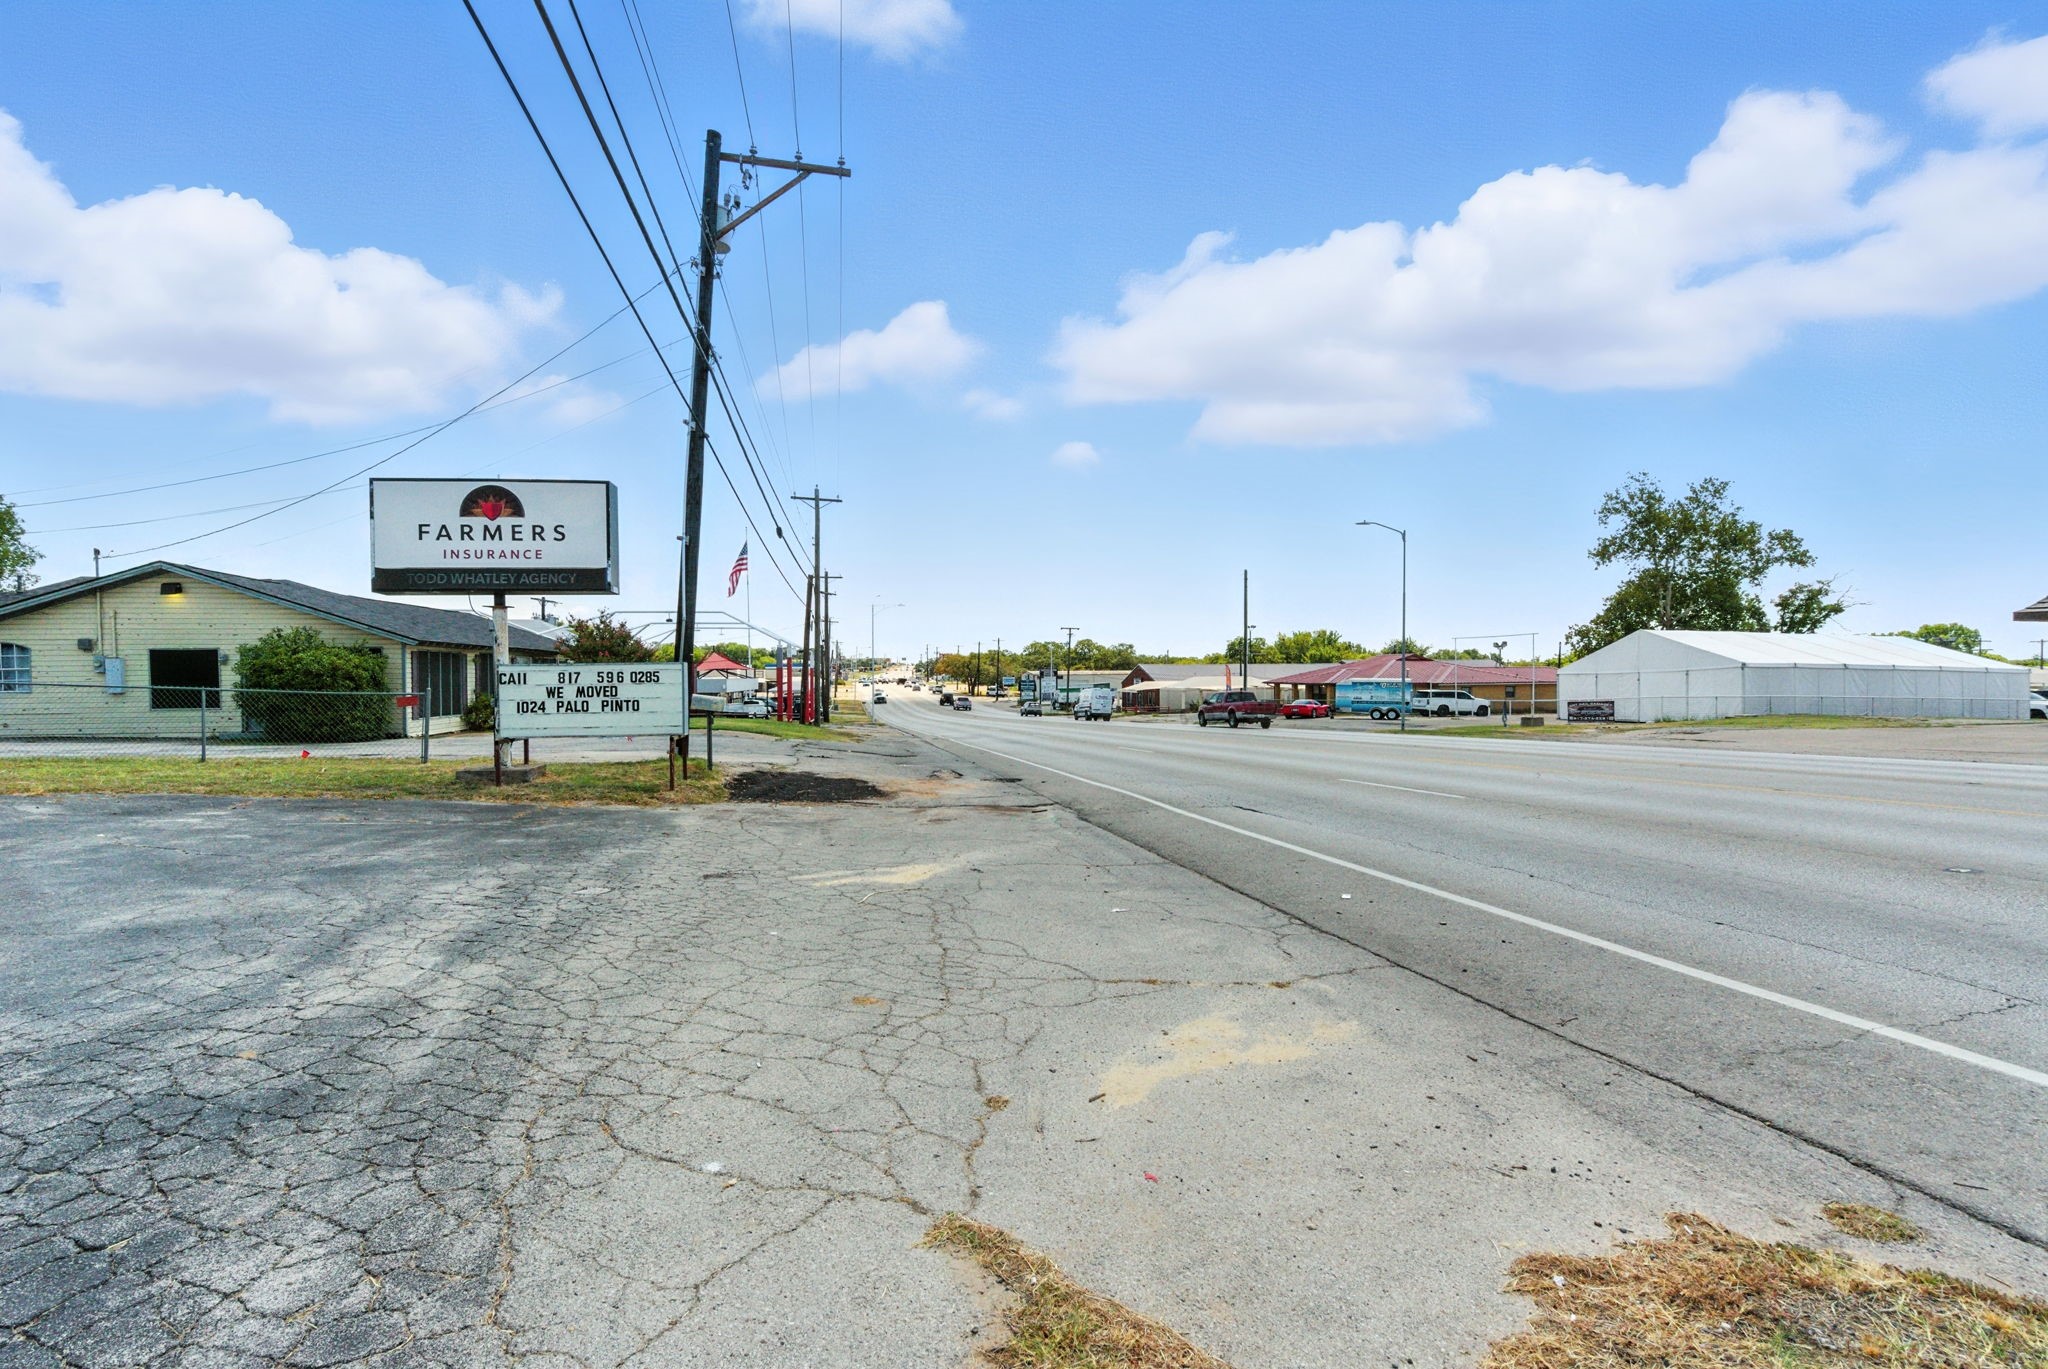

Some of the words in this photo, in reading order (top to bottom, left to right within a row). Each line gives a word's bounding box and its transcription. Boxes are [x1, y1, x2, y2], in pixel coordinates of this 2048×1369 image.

[418, 523, 566, 541] FARMERS
[443, 549, 543, 560] INSURANCE
[407, 573, 447, 584] TODD
[451, 573, 518, 584] WHATLEY
[519, 573, 577, 584] AGENCY
[557, 672, 581, 684] 817
[596, 671, 624, 684] 596
[630, 671, 660, 683] 0285
[546, 686, 564, 699] WE
[575, 685, 618, 698] MOVED
[516, 701, 546, 714] 1024
[556, 700, 589, 713] PALO
[601, 699, 640, 712] PINTO
